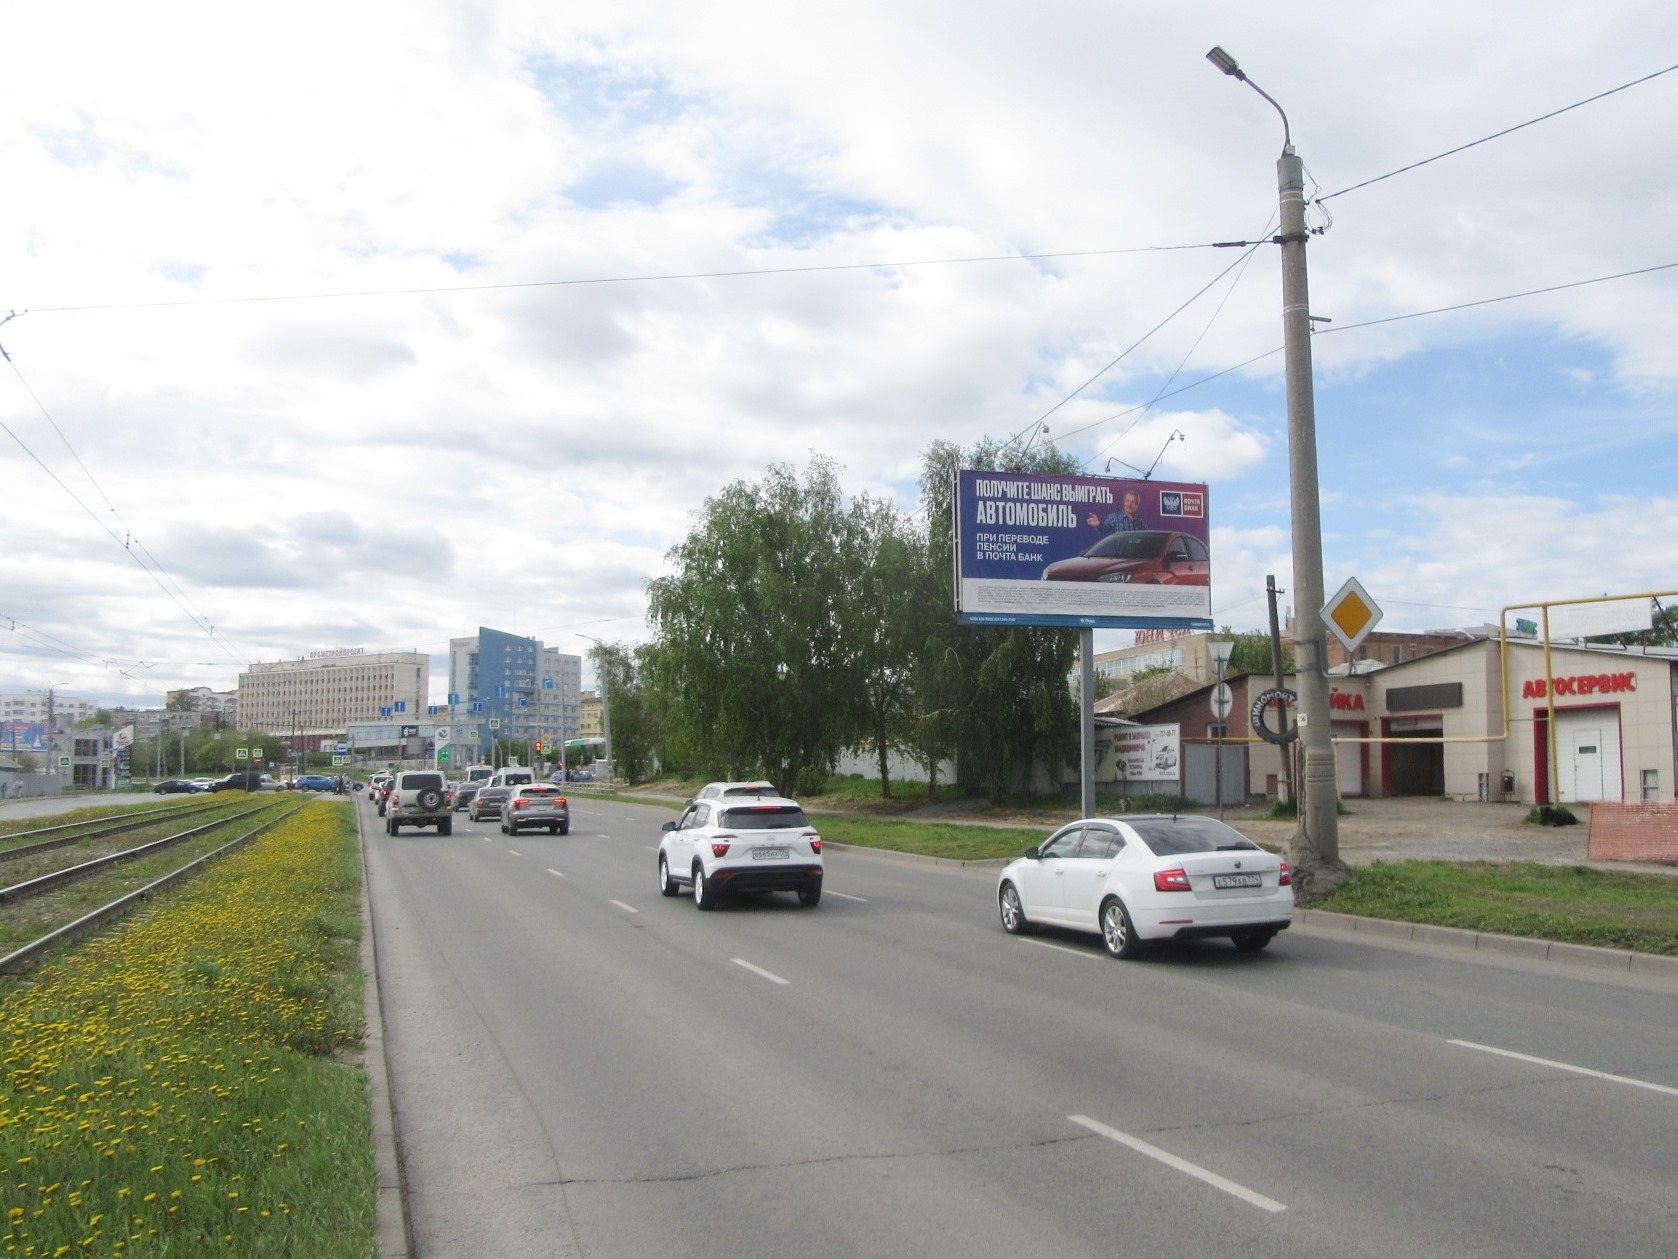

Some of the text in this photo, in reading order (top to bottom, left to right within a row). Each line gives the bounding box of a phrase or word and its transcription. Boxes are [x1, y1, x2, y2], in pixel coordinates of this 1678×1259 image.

[976, 479, 1114, 504] ПОЛУЧИТЕ ШАНС ВЫИГРАТЬ
[976, 500, 1077, 528] АВТОМОБИЛЬ
[1184, 504, 1199, 512] БАНК
[976, 533, 1049, 545] ПРИ ПЕРЕВОДЕ
[976, 542, 1017, 552] ПЕНСИИ
[977, 552, 1043, 562] В ПОЧТА БАНК
[1522, 672, 1635, 699] АВТОСЕРВИС
